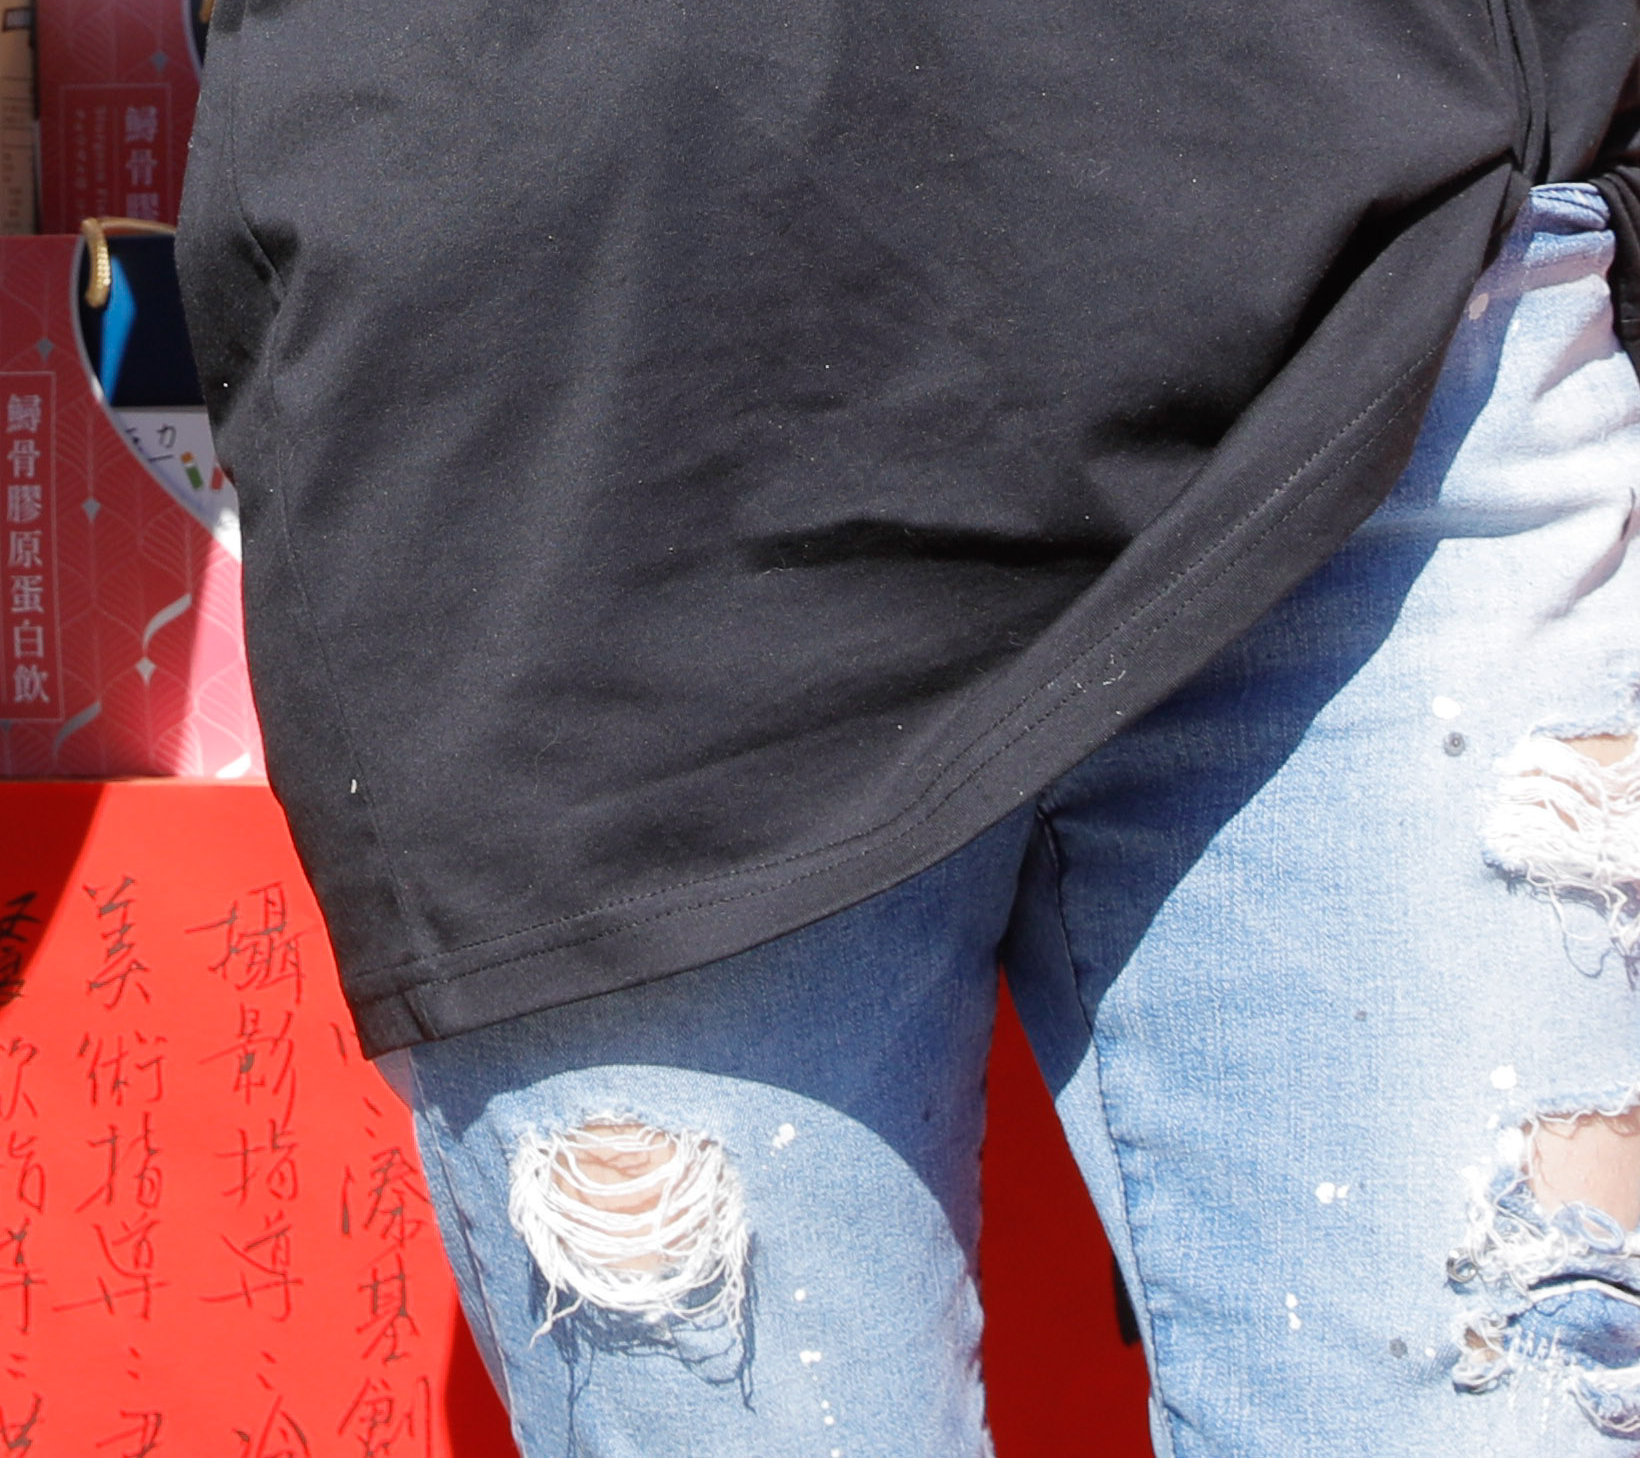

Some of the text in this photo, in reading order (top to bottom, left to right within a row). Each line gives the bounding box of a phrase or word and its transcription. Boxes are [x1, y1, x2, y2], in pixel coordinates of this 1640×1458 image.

[6, 393, 50, 704] 鱘骨膠原蛋白飲
